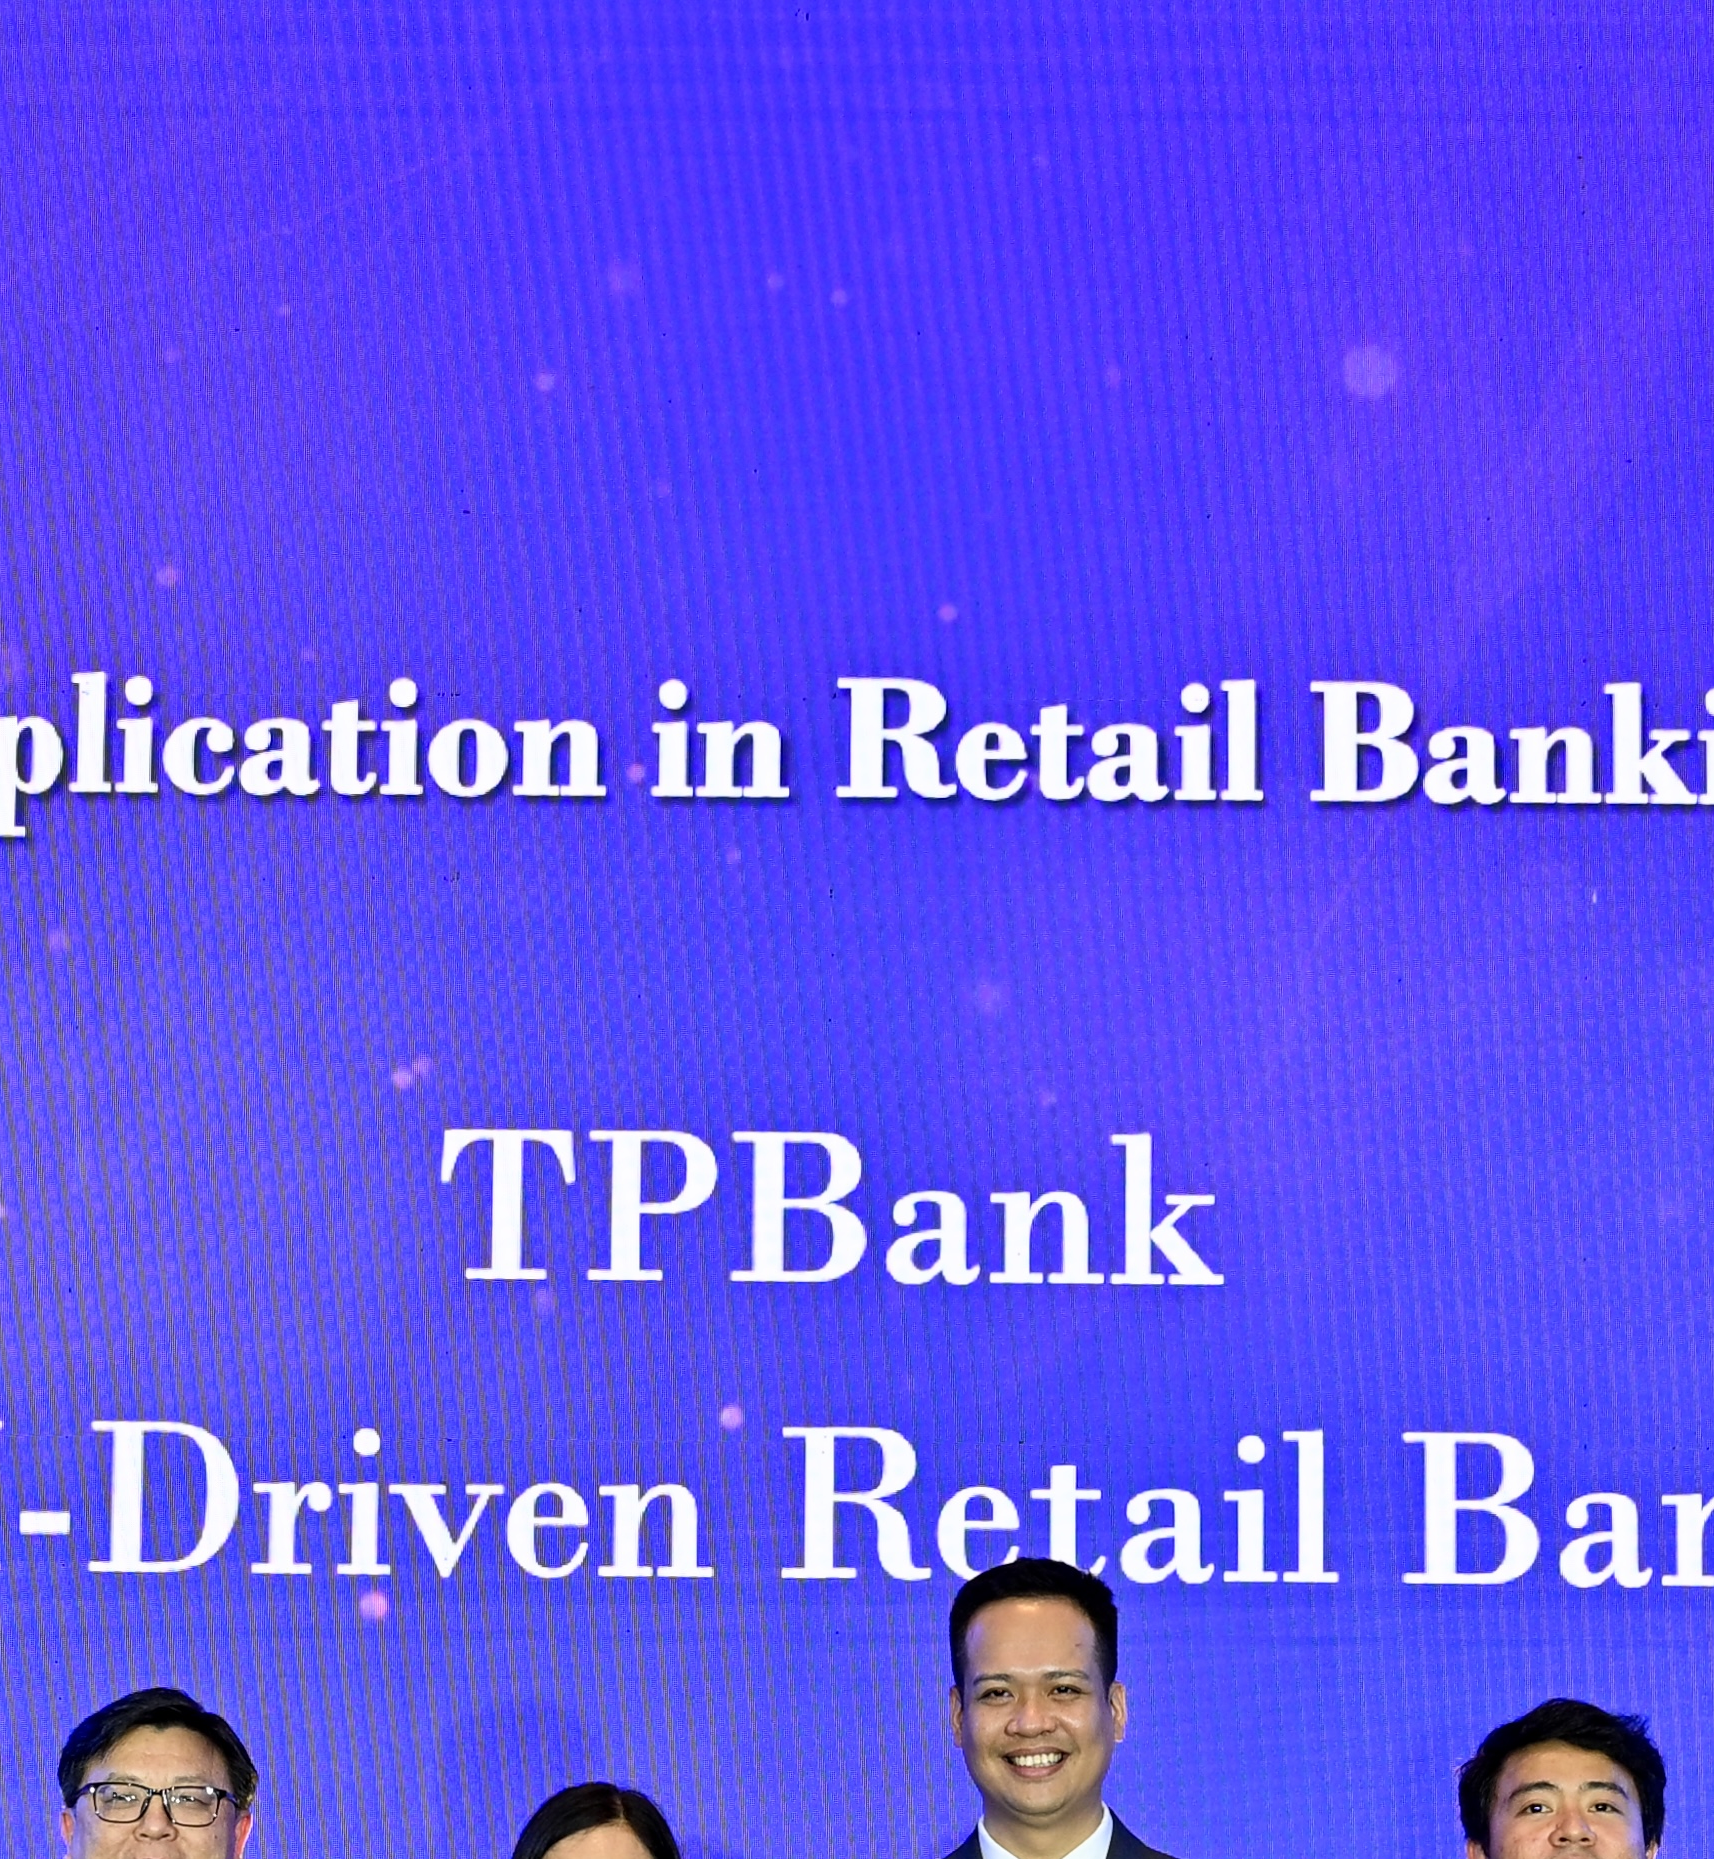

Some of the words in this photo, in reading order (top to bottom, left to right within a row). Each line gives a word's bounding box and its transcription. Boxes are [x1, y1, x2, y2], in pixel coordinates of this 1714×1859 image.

[650, 678, 791, 799] in
[834, 676, 1265, 804] Retail
[439, 1127, 1226, 1287] TPBank
[779, 1425, 1340, 1585] Retail
